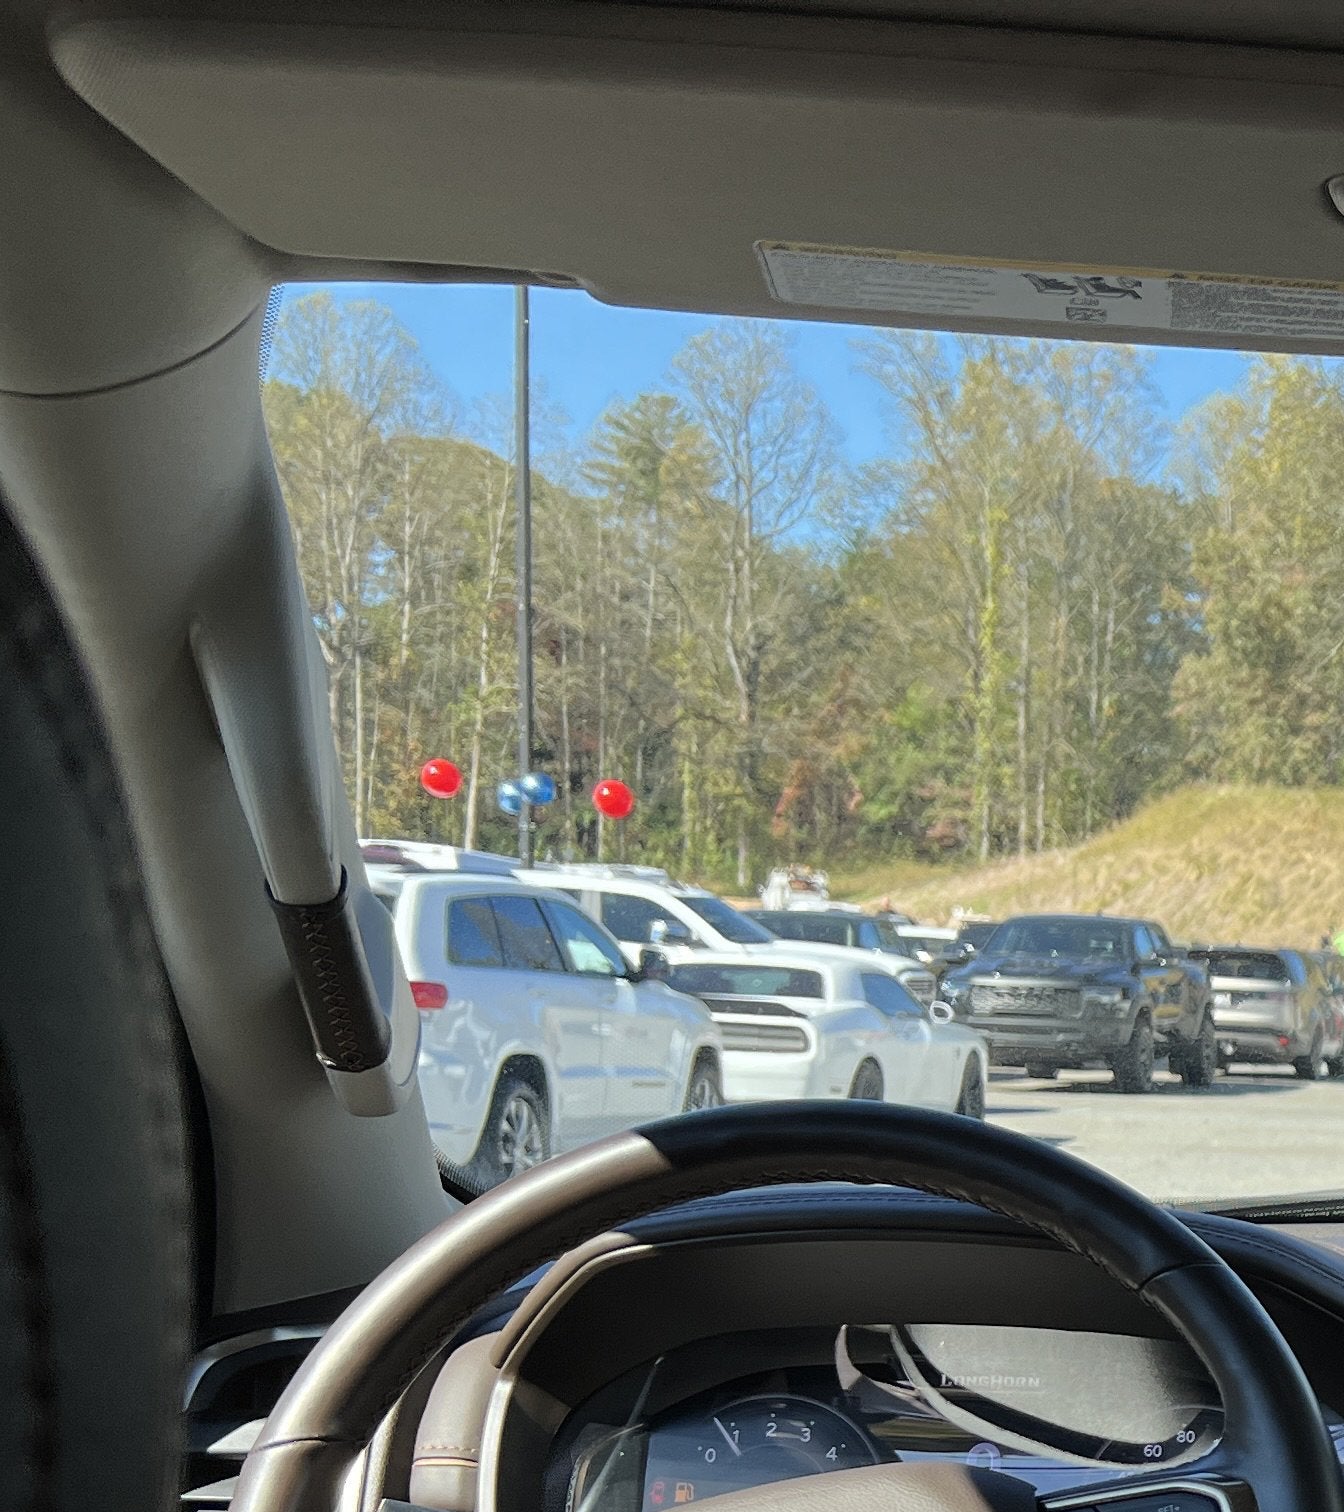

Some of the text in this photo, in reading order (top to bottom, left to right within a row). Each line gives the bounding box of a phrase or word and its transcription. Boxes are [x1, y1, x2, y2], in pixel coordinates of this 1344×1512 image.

[732, 1430, 740, 1444] 1
[766, 1422, 777, 1438] 2
[800, 1427, 812, 1443] 3
[1176, 1430, 1196, 1444] 80
[704, 1447, 717, 1463] 0
[826, 1446, 838, 1461] 4
[1143, 1444, 1163, 1458] 60
